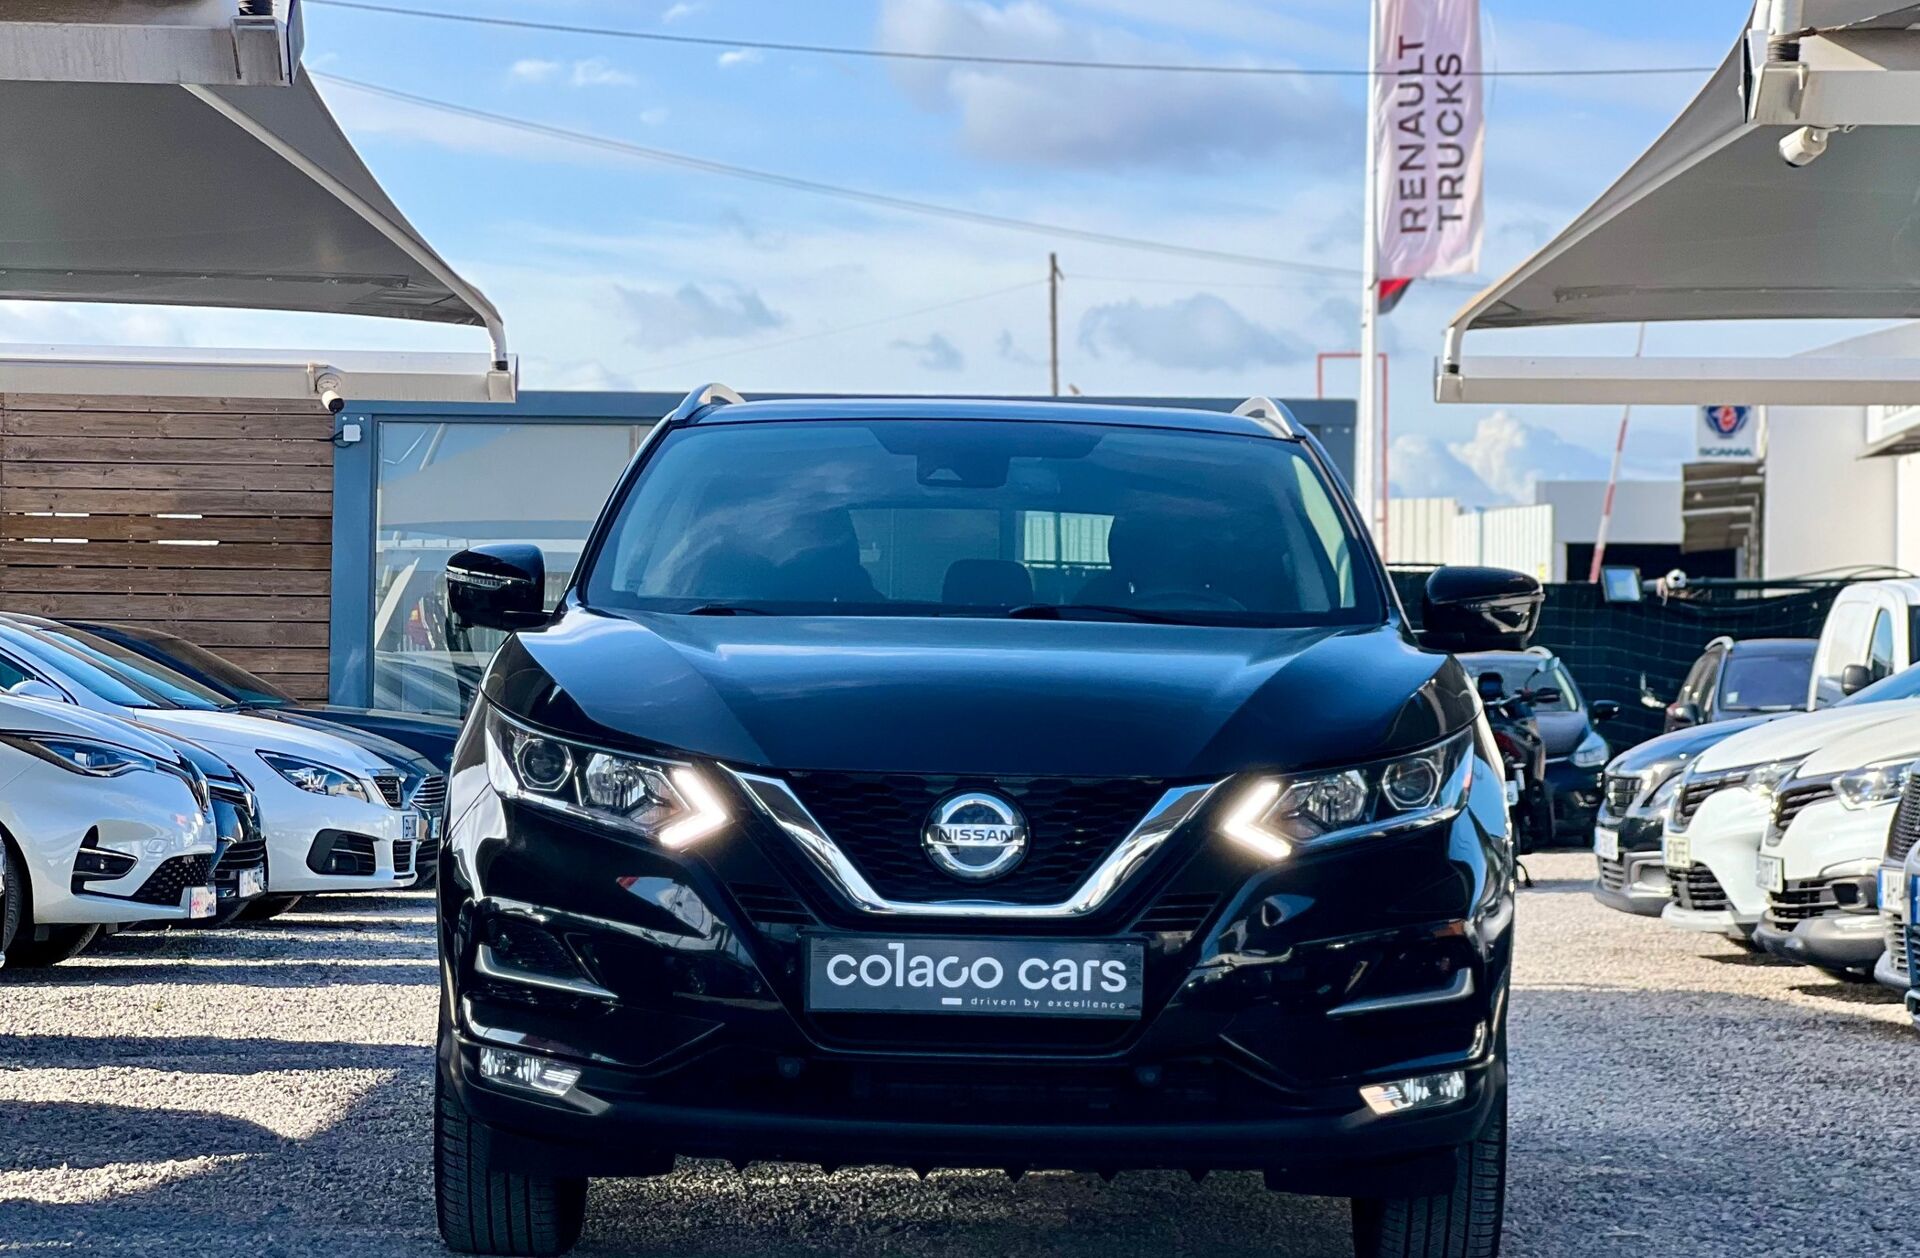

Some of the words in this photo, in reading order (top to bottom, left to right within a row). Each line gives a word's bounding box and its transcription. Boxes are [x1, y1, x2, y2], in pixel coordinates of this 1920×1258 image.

[1397, 35, 1427, 234] RENAULT
[1435, 53, 1465, 231] TRUCKS
[938, 828, 1014, 843] NISSAN
[1018, 957, 1128, 993] cars
[970, 997, 1016, 1007] driven
[1024, 998, 1040, 1009] by
[1047, 998, 1126, 1010] excellence
